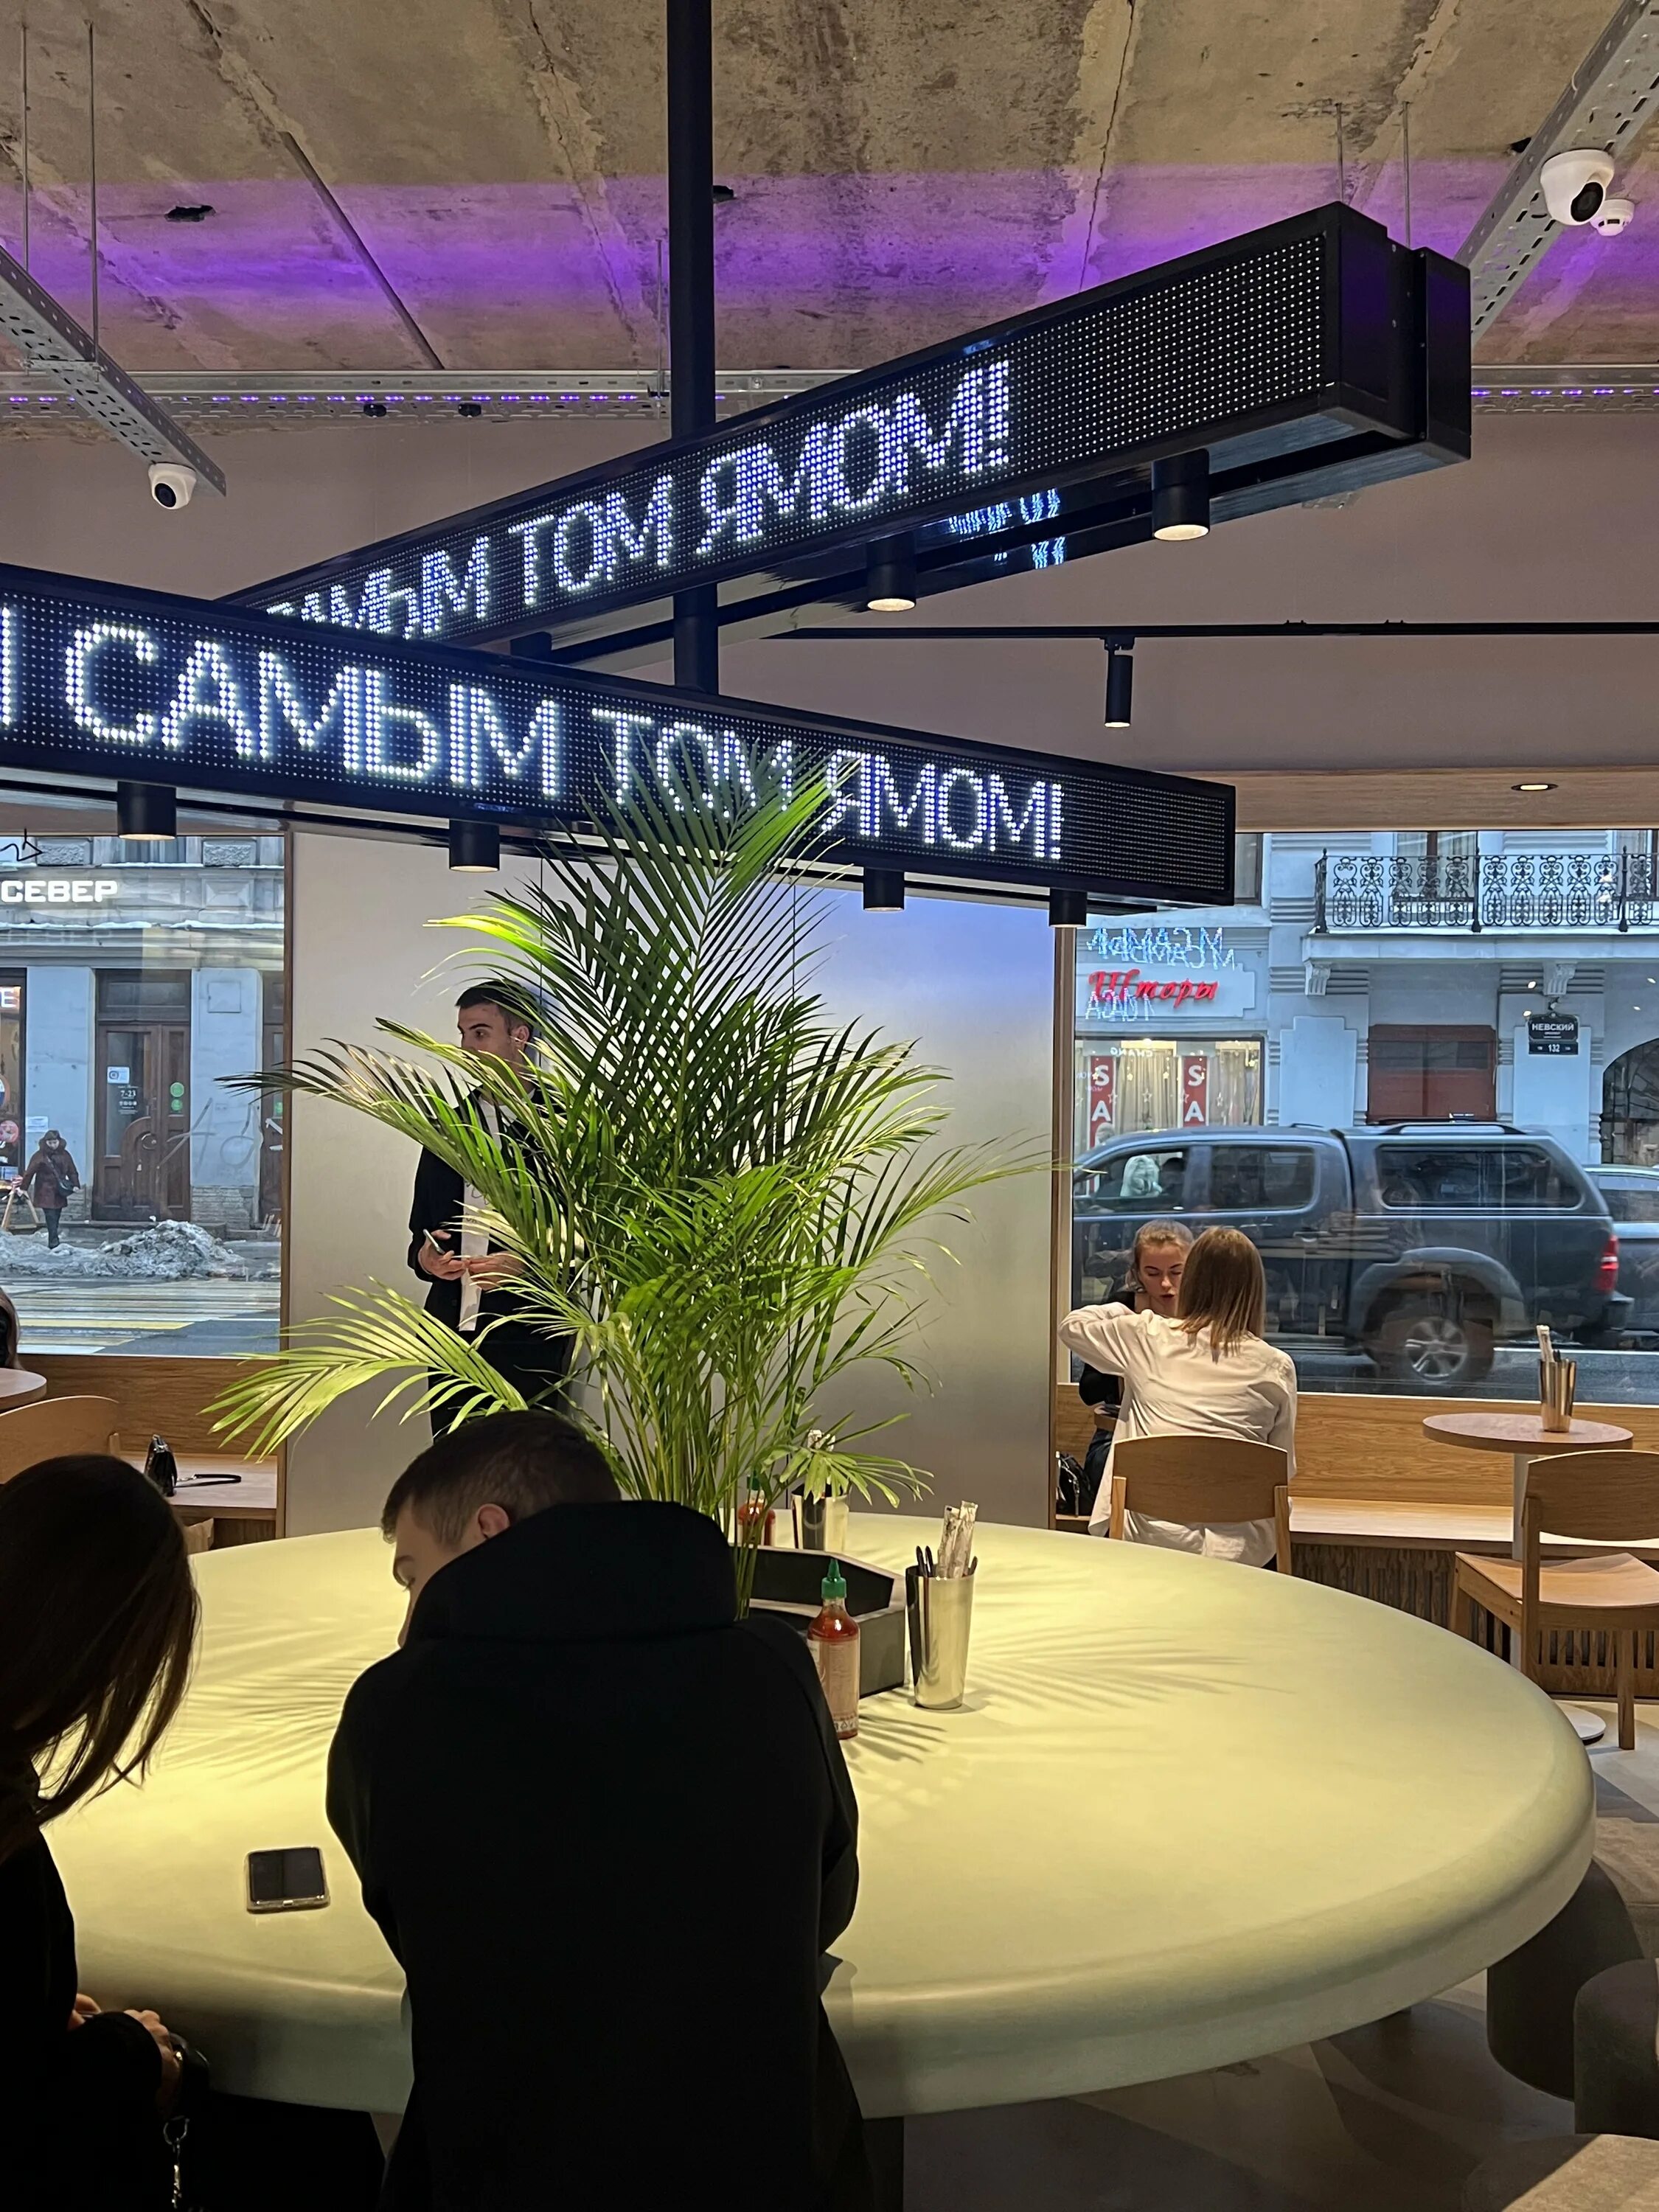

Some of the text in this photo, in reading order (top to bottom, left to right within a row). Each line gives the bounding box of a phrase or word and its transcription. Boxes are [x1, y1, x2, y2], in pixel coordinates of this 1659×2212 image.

[508, 475, 672, 606] ТОМ
[696, 361, 1009, 554] ЯМОМ!
[66, 622, 557, 797] САМЫМ
[591, 708, 793, 817] ТОМ
[822, 748, 1062, 860] ЯМОМ!
[1, 880, 117, 902] СЕВЕР
[1088, 969, 1219, 1009] Шторы
[1531, 1022, 1574, 1031] НЕВСКИЙ
[1548, 1043, 1560, 1052] 132
